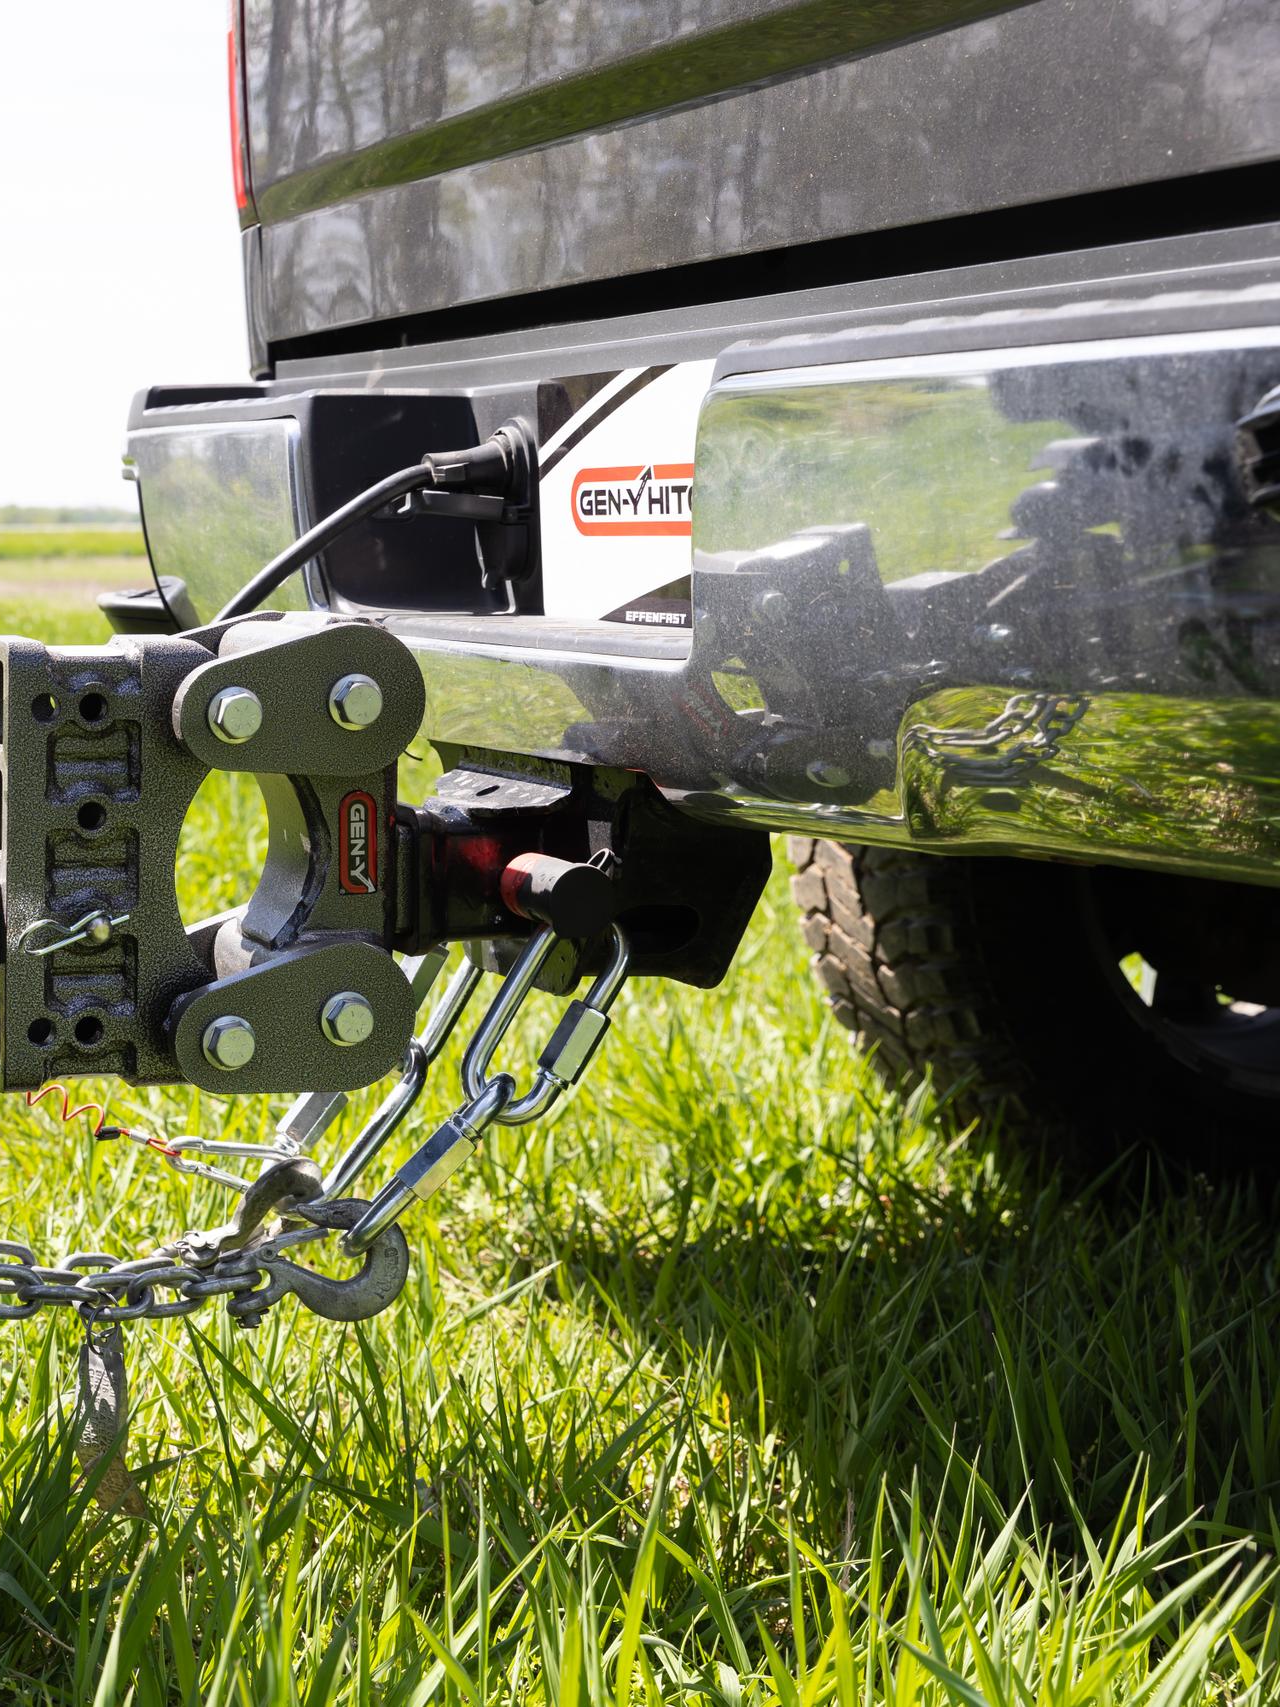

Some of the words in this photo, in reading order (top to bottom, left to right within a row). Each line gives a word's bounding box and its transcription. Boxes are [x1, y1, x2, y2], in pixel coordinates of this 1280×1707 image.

[580, 477, 647, 515] GEN-Y
[625, 610, 687, 625] EFFENFAST
[350, 803, 371, 884] GEN-Y
